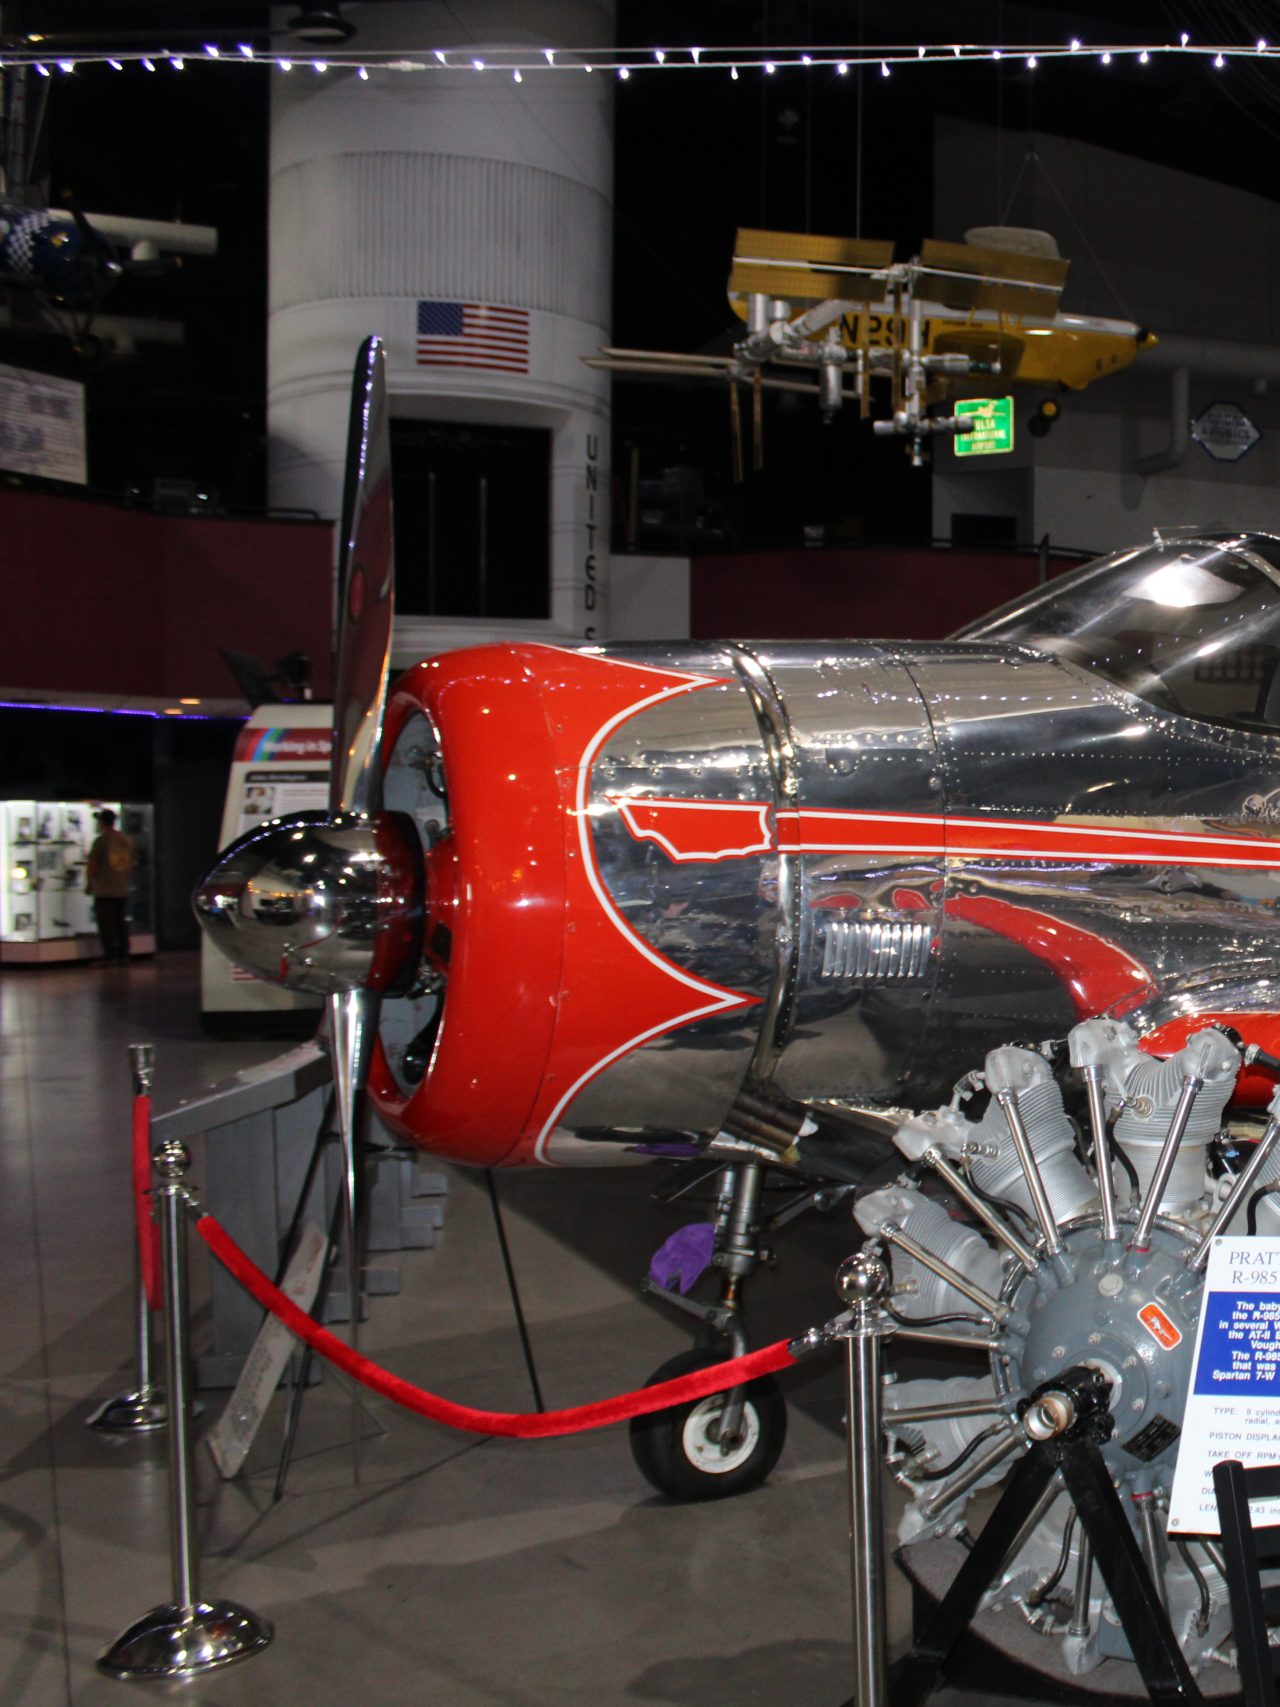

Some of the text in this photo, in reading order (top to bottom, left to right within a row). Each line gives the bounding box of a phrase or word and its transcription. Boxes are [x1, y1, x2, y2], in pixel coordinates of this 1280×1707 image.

[585, 433, 598, 610] UNITED
[1231, 1270, 1277, 1284] R-985
[1236, 1301, 1254, 1310] The
[1232, 1311, 1248, 1320] the
[1253, 1311, 1280, 1320] R-985
[1219, 1320, 1228, 1329] in
[1233, 1321, 1268, 1330] several
[1228, 1330, 1244, 1339] the
[1231, 1351, 1250, 1360] The
[1232, 1361, 1252, 1370] that
[1256, 1363, 1276, 1371] was
[1212, 1370, 1251, 1381] Spartan
[1256, 1371, 1276, 1380] 7-W
[1213, 1407, 1238, 1415] TYPE:
[1245, 1417, 1270, 1425] radial,
[1209, 1432, 1242, 1440] PISTON
[1207, 1450, 1230, 1458] TAKE
[1234, 1451, 1252, 1459] OFF
